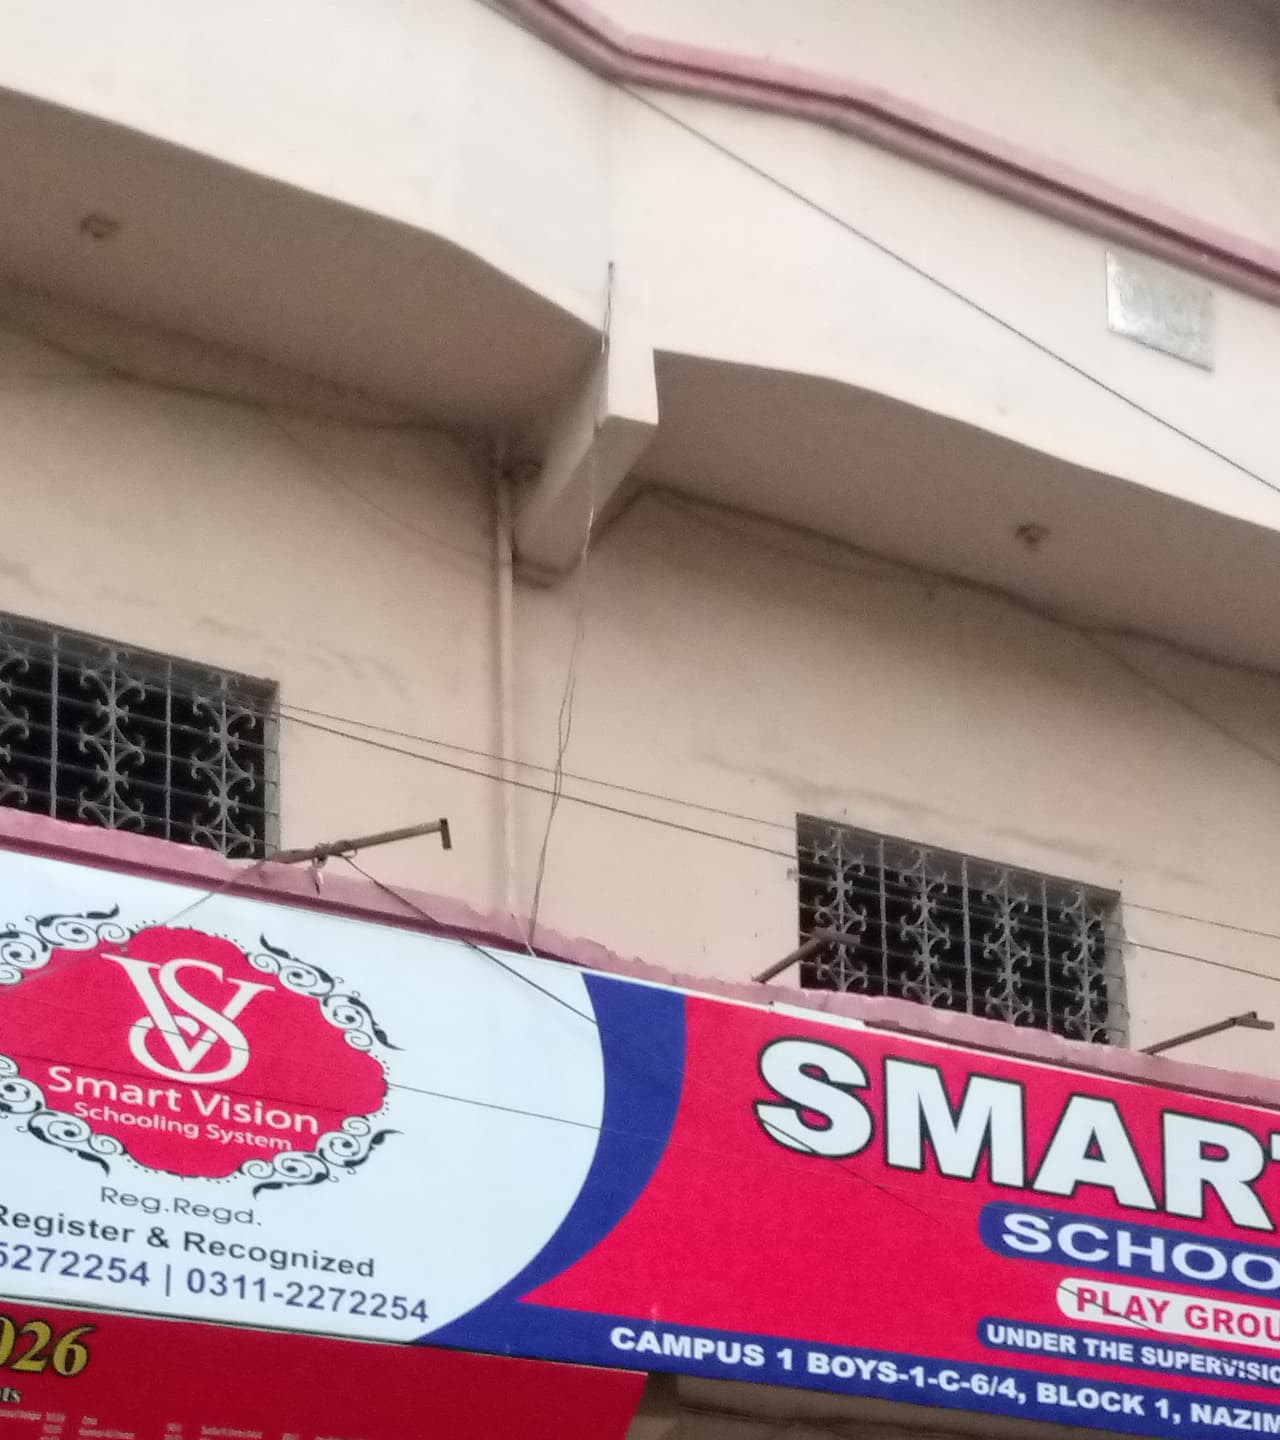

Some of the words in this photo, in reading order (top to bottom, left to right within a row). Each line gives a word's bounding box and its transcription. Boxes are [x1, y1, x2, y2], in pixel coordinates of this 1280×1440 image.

[48, 1065, 182, 1112] Smart
[192, 1090, 319, 1134] Vision
[74, 1102, 200, 1139] Schooling
[206, 1124, 292, 1151] System
[147, 1226, 169, 1249] &
[184, 1231, 374, 1277] Recognized
[187, 1268, 428, 1322] 0311-2272254
[1076, 1286, 1170, 1324] PLAY
[987, 1324, 1077, 1355] UNDER
[1083, 1337, 1133, 1362] THE
[610, 1327, 765, 1368] CAMPUS
[777, 1348, 793, 1370] 1
[807, 1352, 1025, 1404] BOYS-1-C-6/4,
[1037, 1382, 1144, 1416] BLOCK
[1154, 1399, 1181, 1424] 1,
